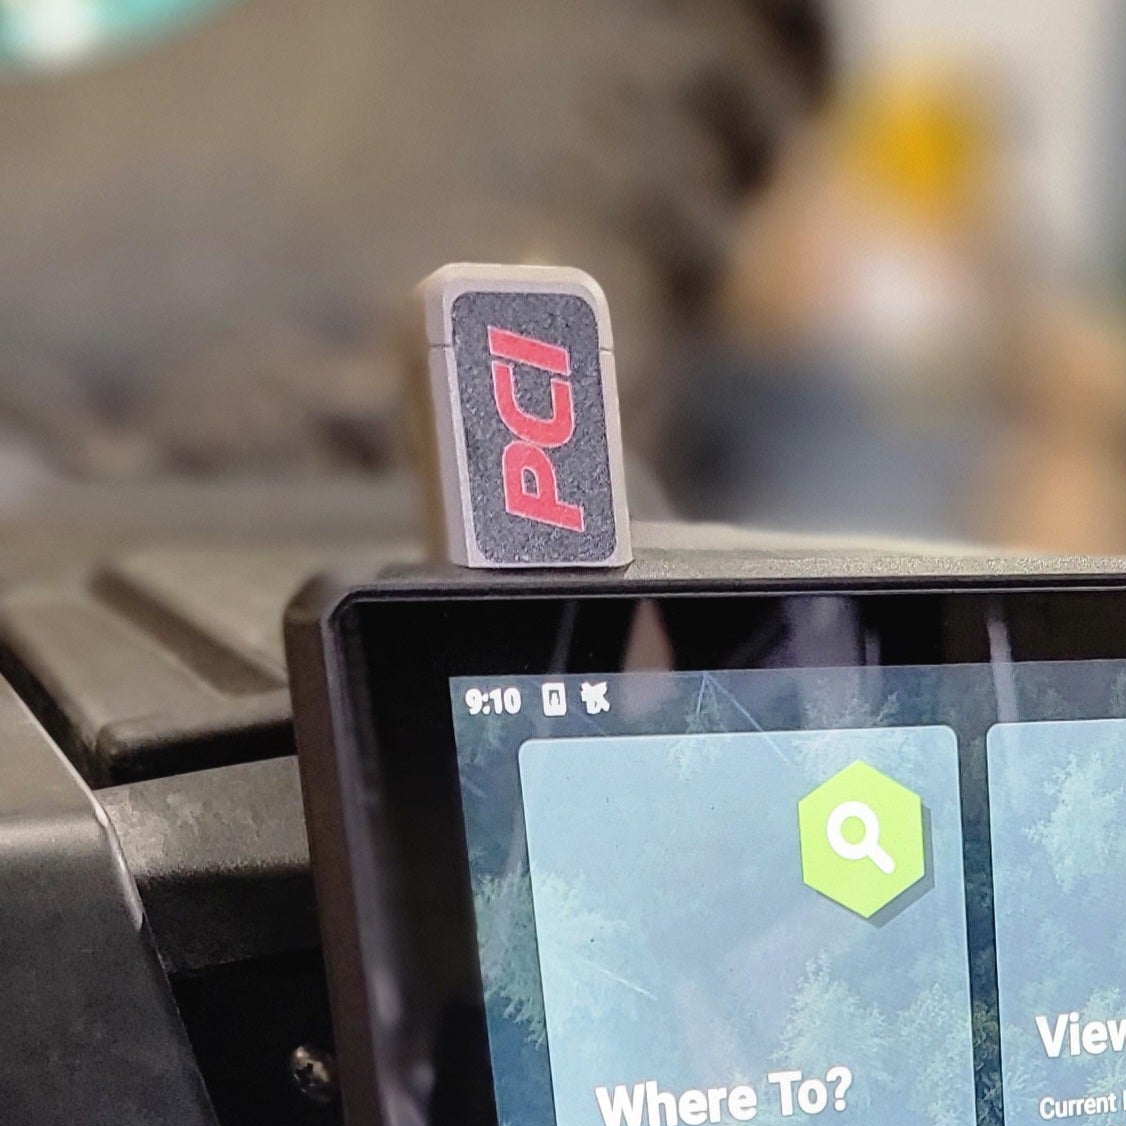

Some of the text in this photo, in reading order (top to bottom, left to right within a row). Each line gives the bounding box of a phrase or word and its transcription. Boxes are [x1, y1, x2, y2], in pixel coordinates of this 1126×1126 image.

[487, 325, 584, 532] PCI
[464, 687, 521, 715] 9:10
[767, 1065, 853, 1117] To?
[1039, 1091, 1116, 1120] Current
